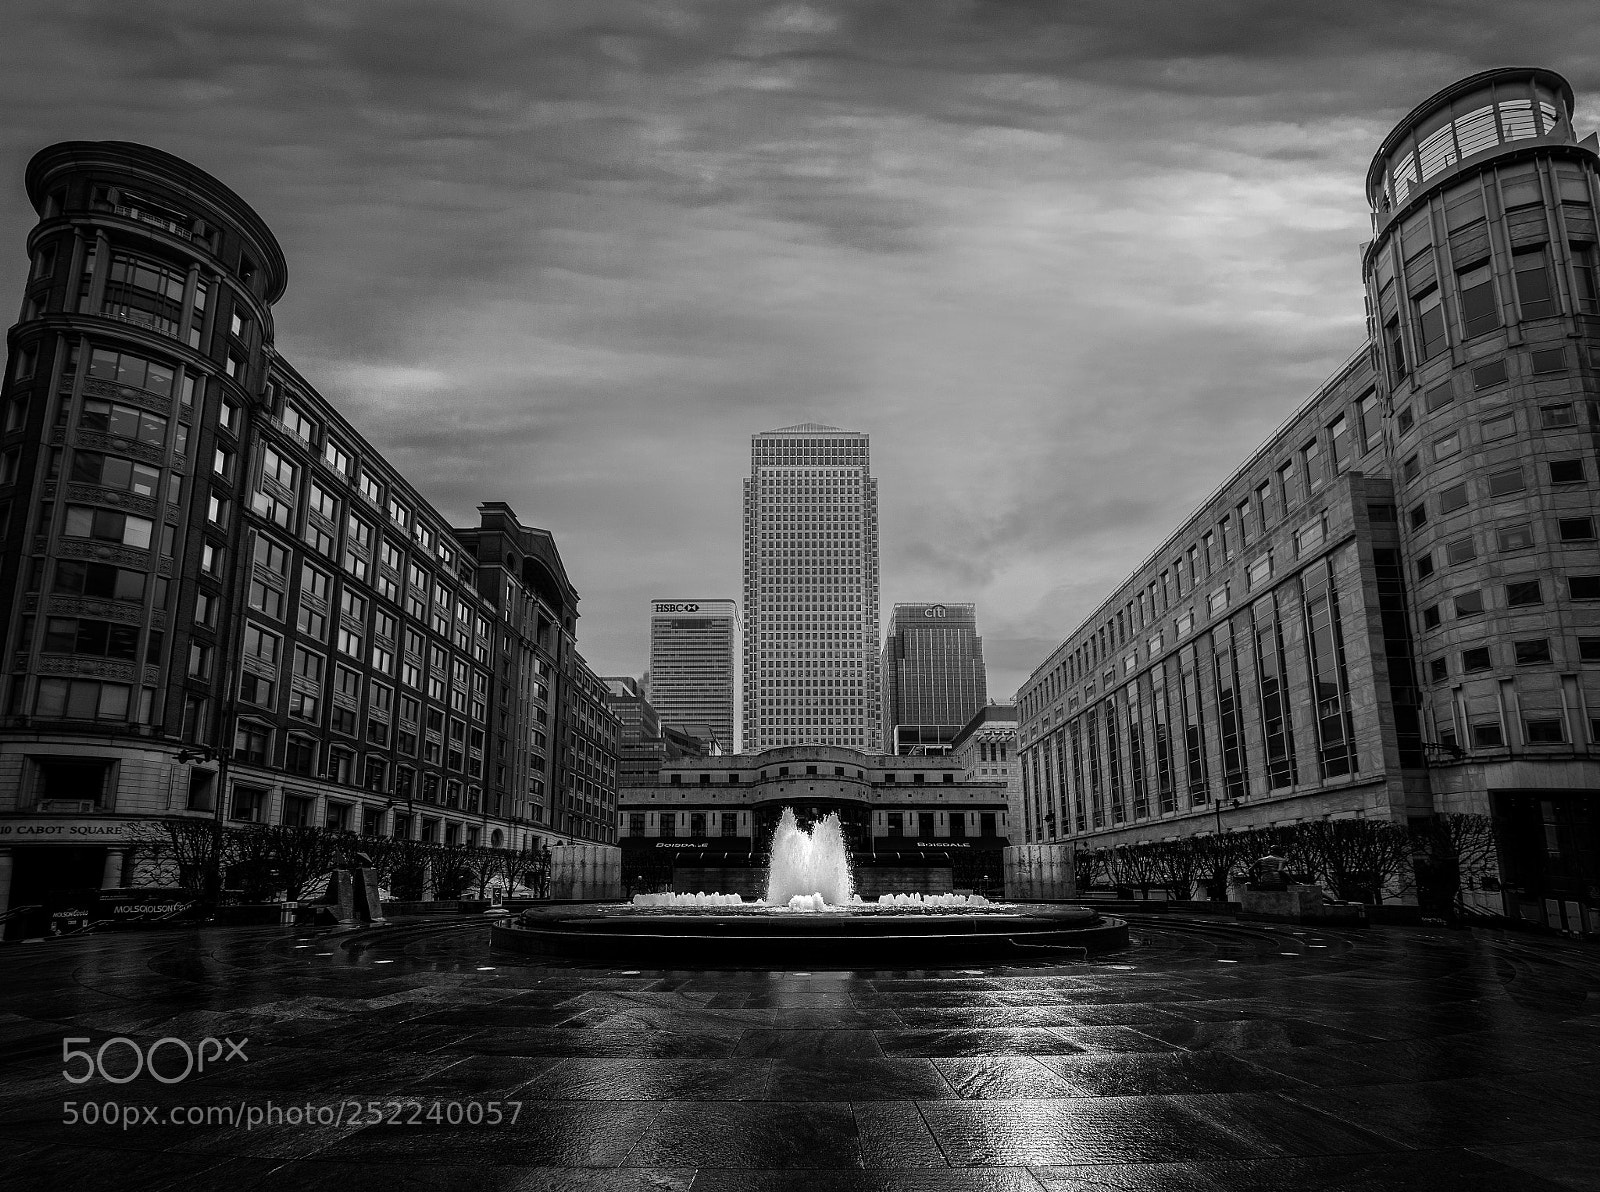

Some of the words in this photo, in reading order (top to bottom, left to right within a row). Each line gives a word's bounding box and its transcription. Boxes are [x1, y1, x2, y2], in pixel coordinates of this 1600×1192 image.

[655, 603, 684, 613] HSBC
[0, 826, 12, 834] 10
[17, 826, 65, 834] CABOT
[69, 826, 123, 835] SQUARE
